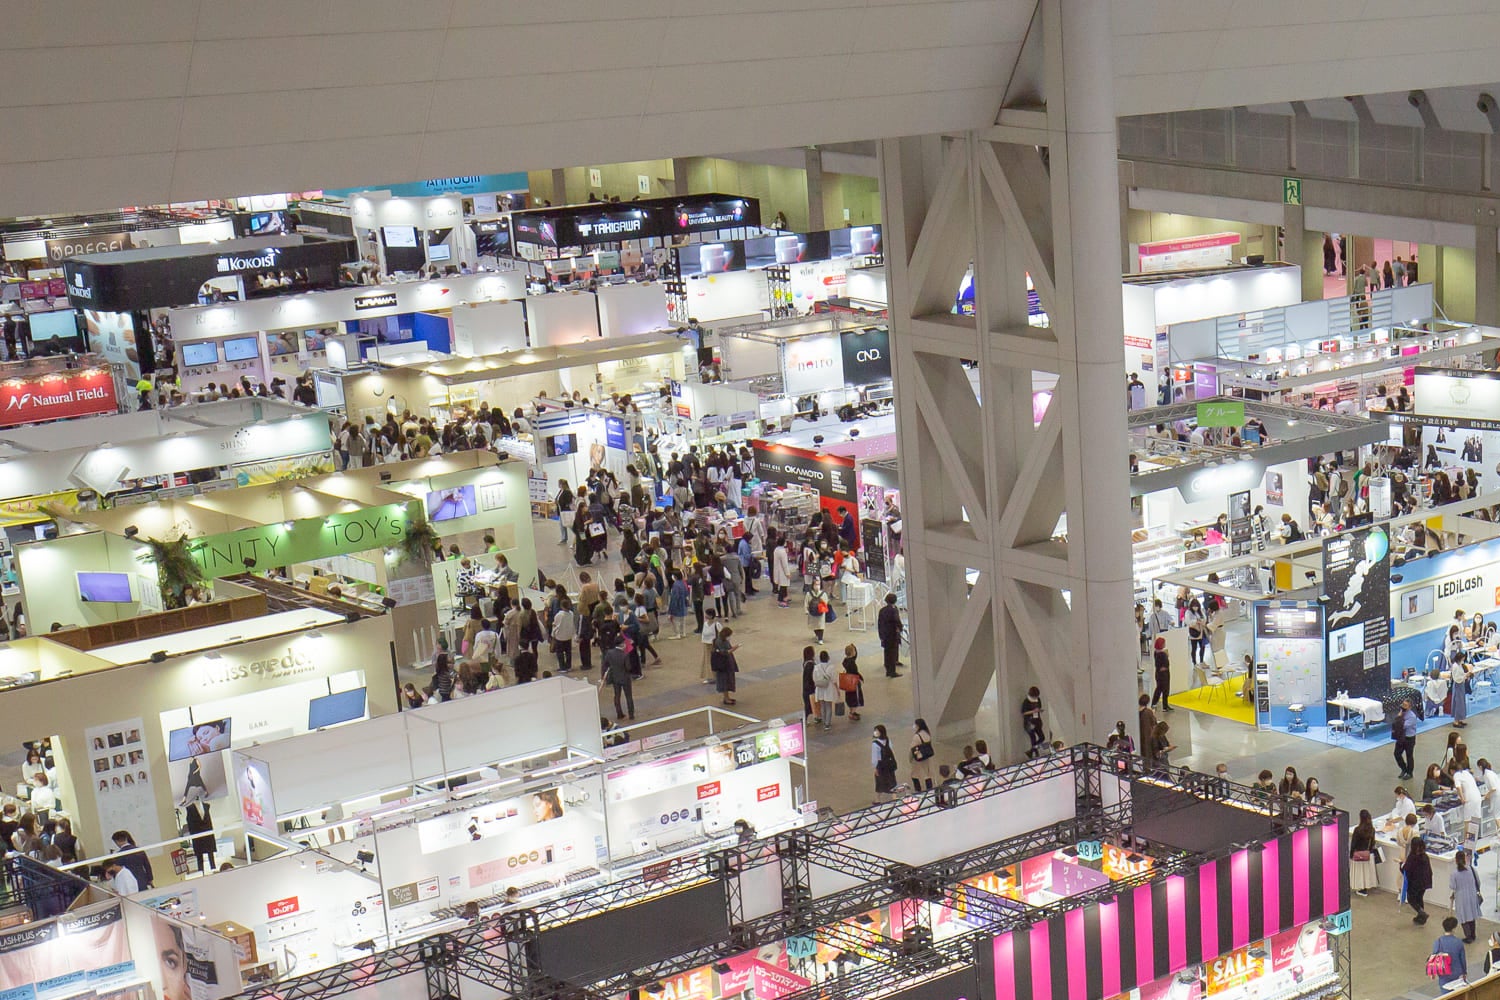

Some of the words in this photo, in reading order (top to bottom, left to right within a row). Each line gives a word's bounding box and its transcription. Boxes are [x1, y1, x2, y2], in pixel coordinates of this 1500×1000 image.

[593, 220, 641, 235] TAKIGAWA
[229, 253, 275, 271] KOKOIST
[32, 391, 74, 408] Natural
[1204, 407, 1237, 418] グルー
[784, 464, 824, 480] OKAMOTO
[1437, 575, 1483, 600] LEDiLash
[1339, 915, 1349, 930] A1
[2, 930, 36, 947] ASH-PLUS
[787, 941, 798, 952] A7
[800, 939, 814, 953] A7
[1213, 953, 1256, 981] SALE
